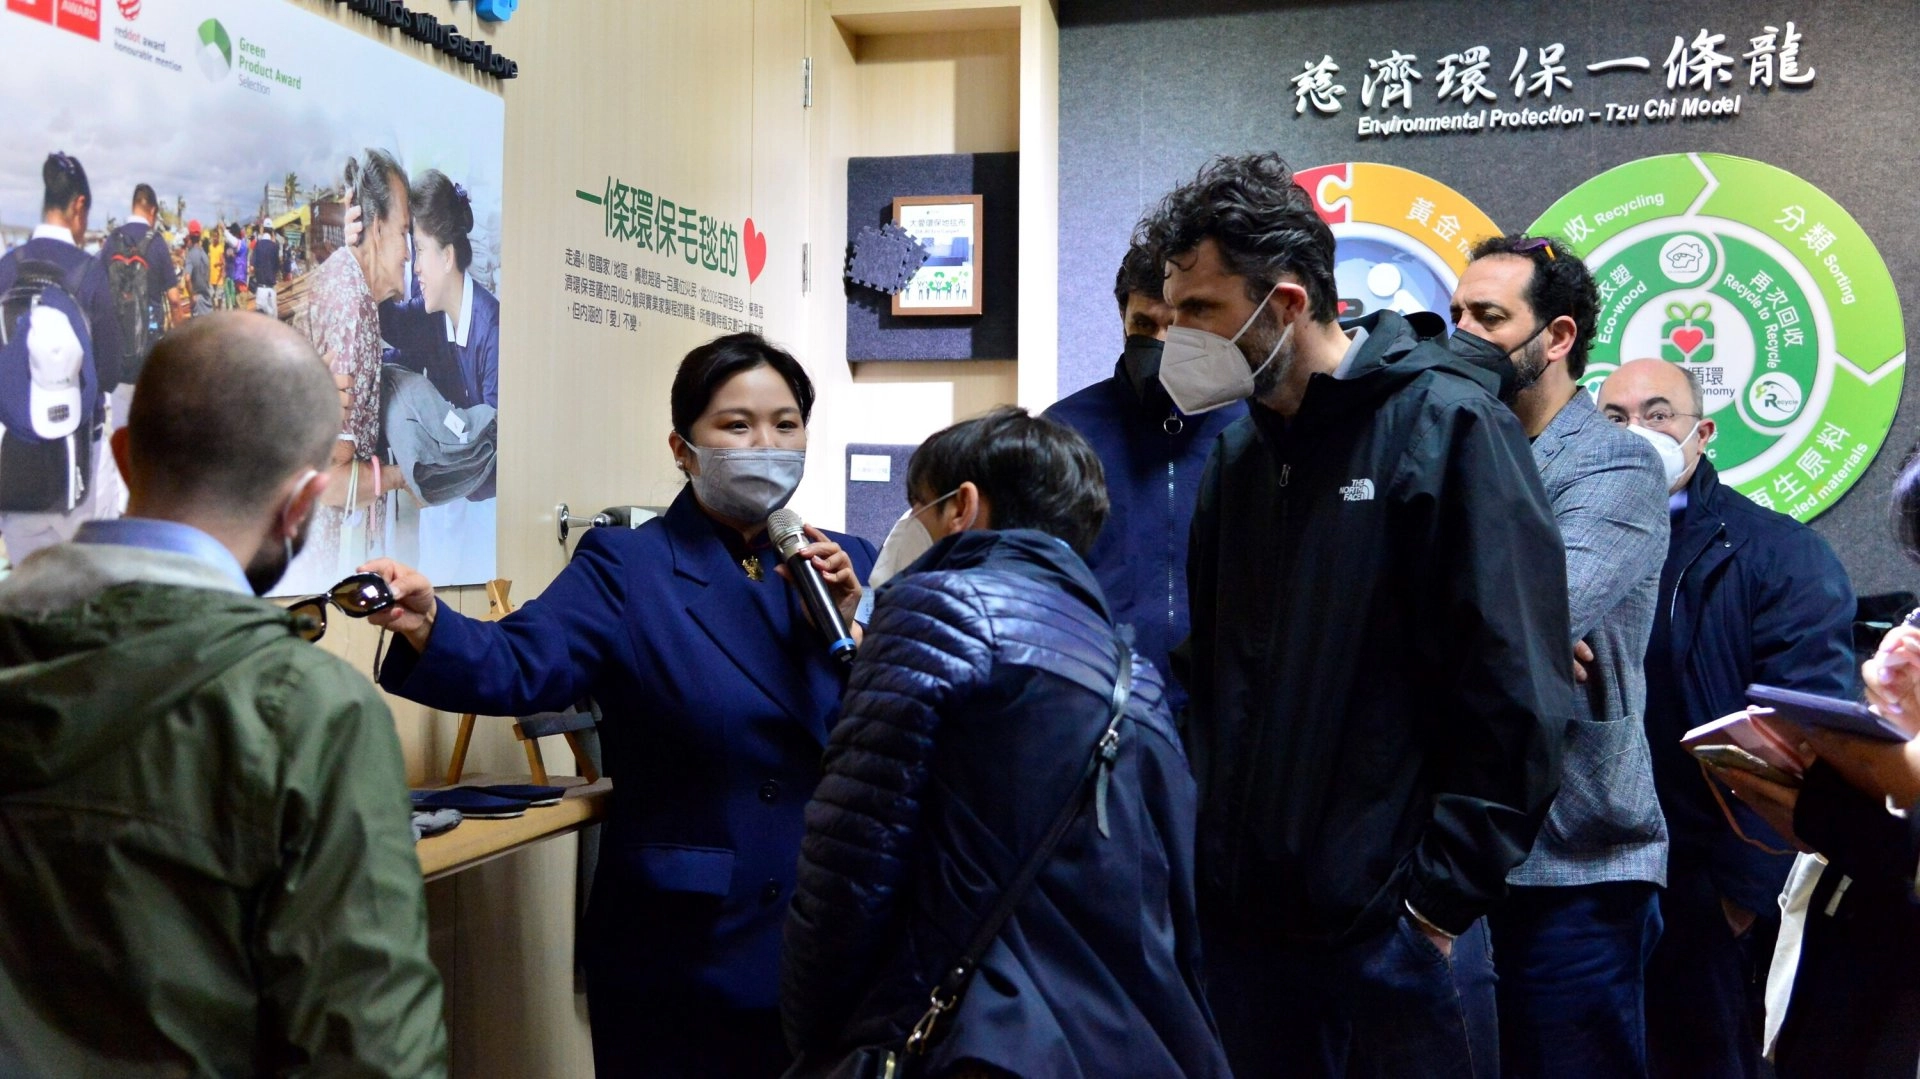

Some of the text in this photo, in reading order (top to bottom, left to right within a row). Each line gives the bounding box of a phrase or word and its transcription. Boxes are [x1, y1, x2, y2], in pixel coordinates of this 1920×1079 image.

[114, 41, 183, 72] honourable mention
[143, 37, 166, 53] award
[239, 37, 266, 58] Green
[449, 25, 487, 63] Great
[489, 45, 518, 78] Love
[1290, 21, 1815, 113] 慈濟環保一條龍
[239, 55, 302, 90] Product Award
[239, 73, 271, 96] Selection
[1358, 109, 1487, 136] Environmental
[1489, 105, 1585, 127] Protection
[1605, 102, 1640, 122] Tzu
[1644, 97, 1677, 119] Chi
[1681, 94, 1741, 117] Model
[575, 175, 738, 278] 一條環保毛毯的
[1405, 196, 1461, 243] 黃金
[1594, 192, 1665, 227] Recycling
[1773, 204, 1838, 257] 分類
[1823, 253, 1857, 305] Sorting
[1597, 280, 1648, 344] Eco-wood
[1723, 273, 1781, 369] Recycle to Recycle
[1749, 270, 1804, 347] 再次回收
[1339, 486, 1364, 494] NORTH
[1352, 479, 1365, 487] THE
[1745, 421, 1851, 512] 再生原料
[1817, 442, 1869, 500] materials
[1344, 493, 1361, 501] FACE
